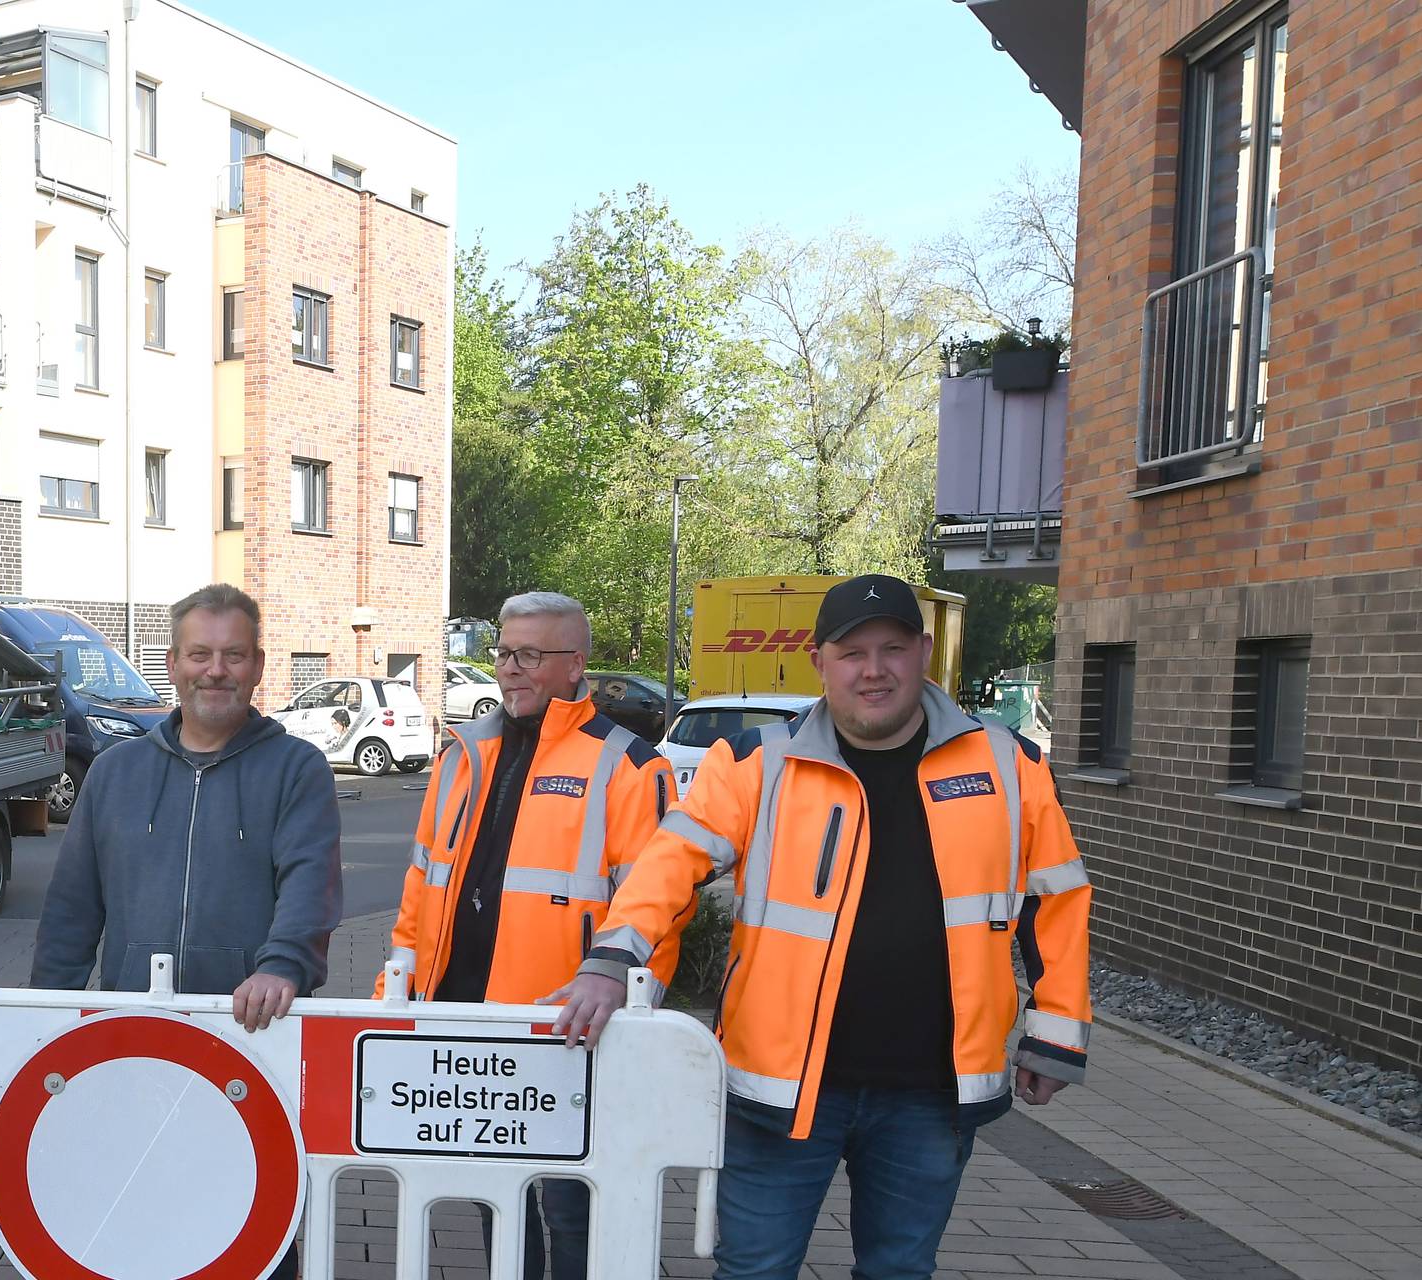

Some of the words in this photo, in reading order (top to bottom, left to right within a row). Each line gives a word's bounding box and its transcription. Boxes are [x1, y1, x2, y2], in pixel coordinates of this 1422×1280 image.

[432, 1049, 517, 1077] Heute
[391, 1082, 556, 1114] Spielstraße
[417, 1118, 463, 1143] auf
[473, 1119, 527, 1145] Zeit
